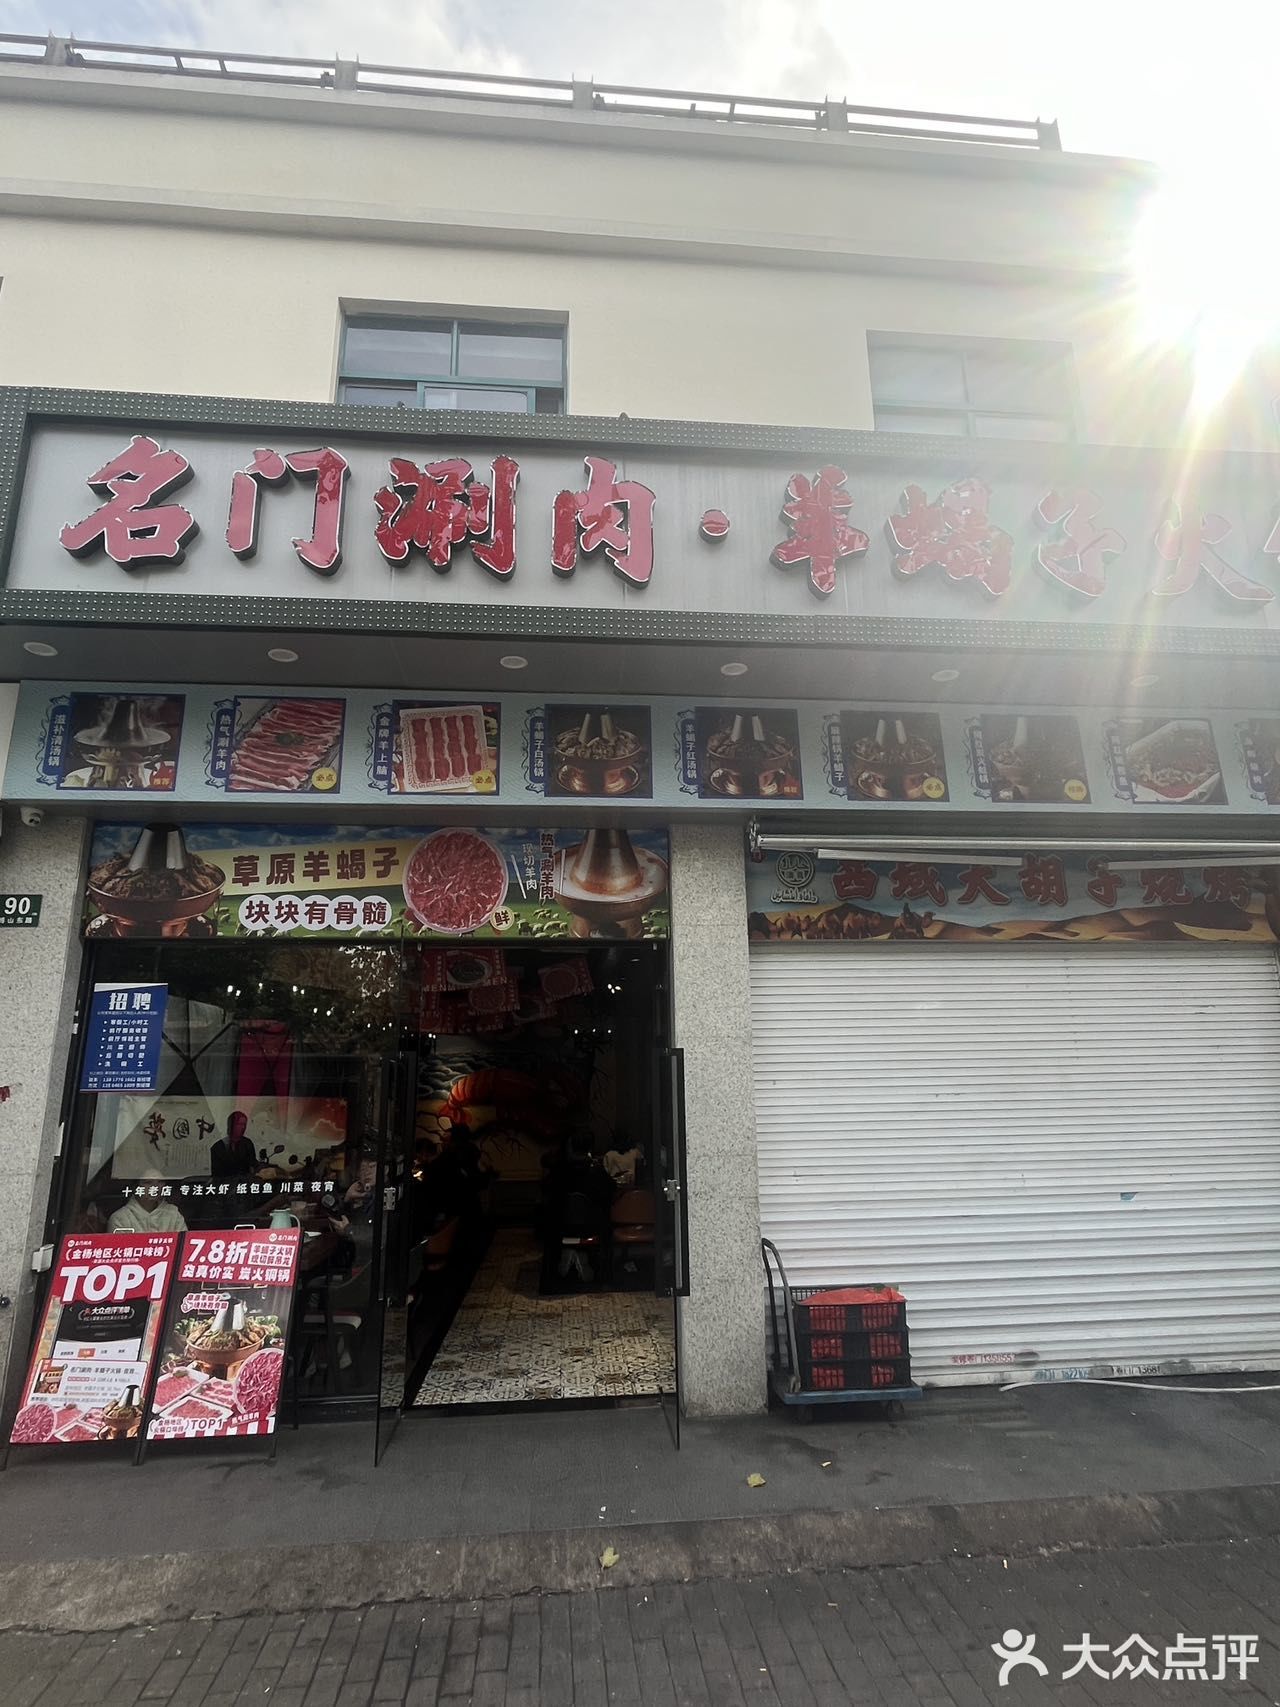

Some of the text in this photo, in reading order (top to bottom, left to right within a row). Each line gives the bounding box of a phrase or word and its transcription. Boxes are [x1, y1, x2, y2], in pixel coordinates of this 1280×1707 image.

[59, 434, 1280, 603] 名门涮肉·羊蝎子火
[215, 714, 232, 770] 热气涮羊肉
[534, 721, 545, 782] 羊蝎子白汤锅
[685, 723, 698, 779] 羊蝎子红汤锅
[231, 847, 400, 887] 草原羊蝎子
[522, 843, 538, 890] 现切羊肉
[540, 832, 555, 899] 热气涮羊肉
[4, 897, 31, 915] 90
[245, 900, 387, 925] 块块有骨髓
[493, 911, 510, 925] 鲜
[109, 992, 152, 1010] 招聘
[121, 1181, 335, 1198] 十年老店 专注大虾 纸包鱼 川菜 夜宵
[188, 1238, 249, 1264] 7.8折
[253, 1244, 293, 1256] 羊蝎子火锅
[60, 1261, 169, 1301] TOP1
[182, 1264, 291, 1282] 货真价实 炭火铜锅
[191, 1418, 223, 1430] TOP1
